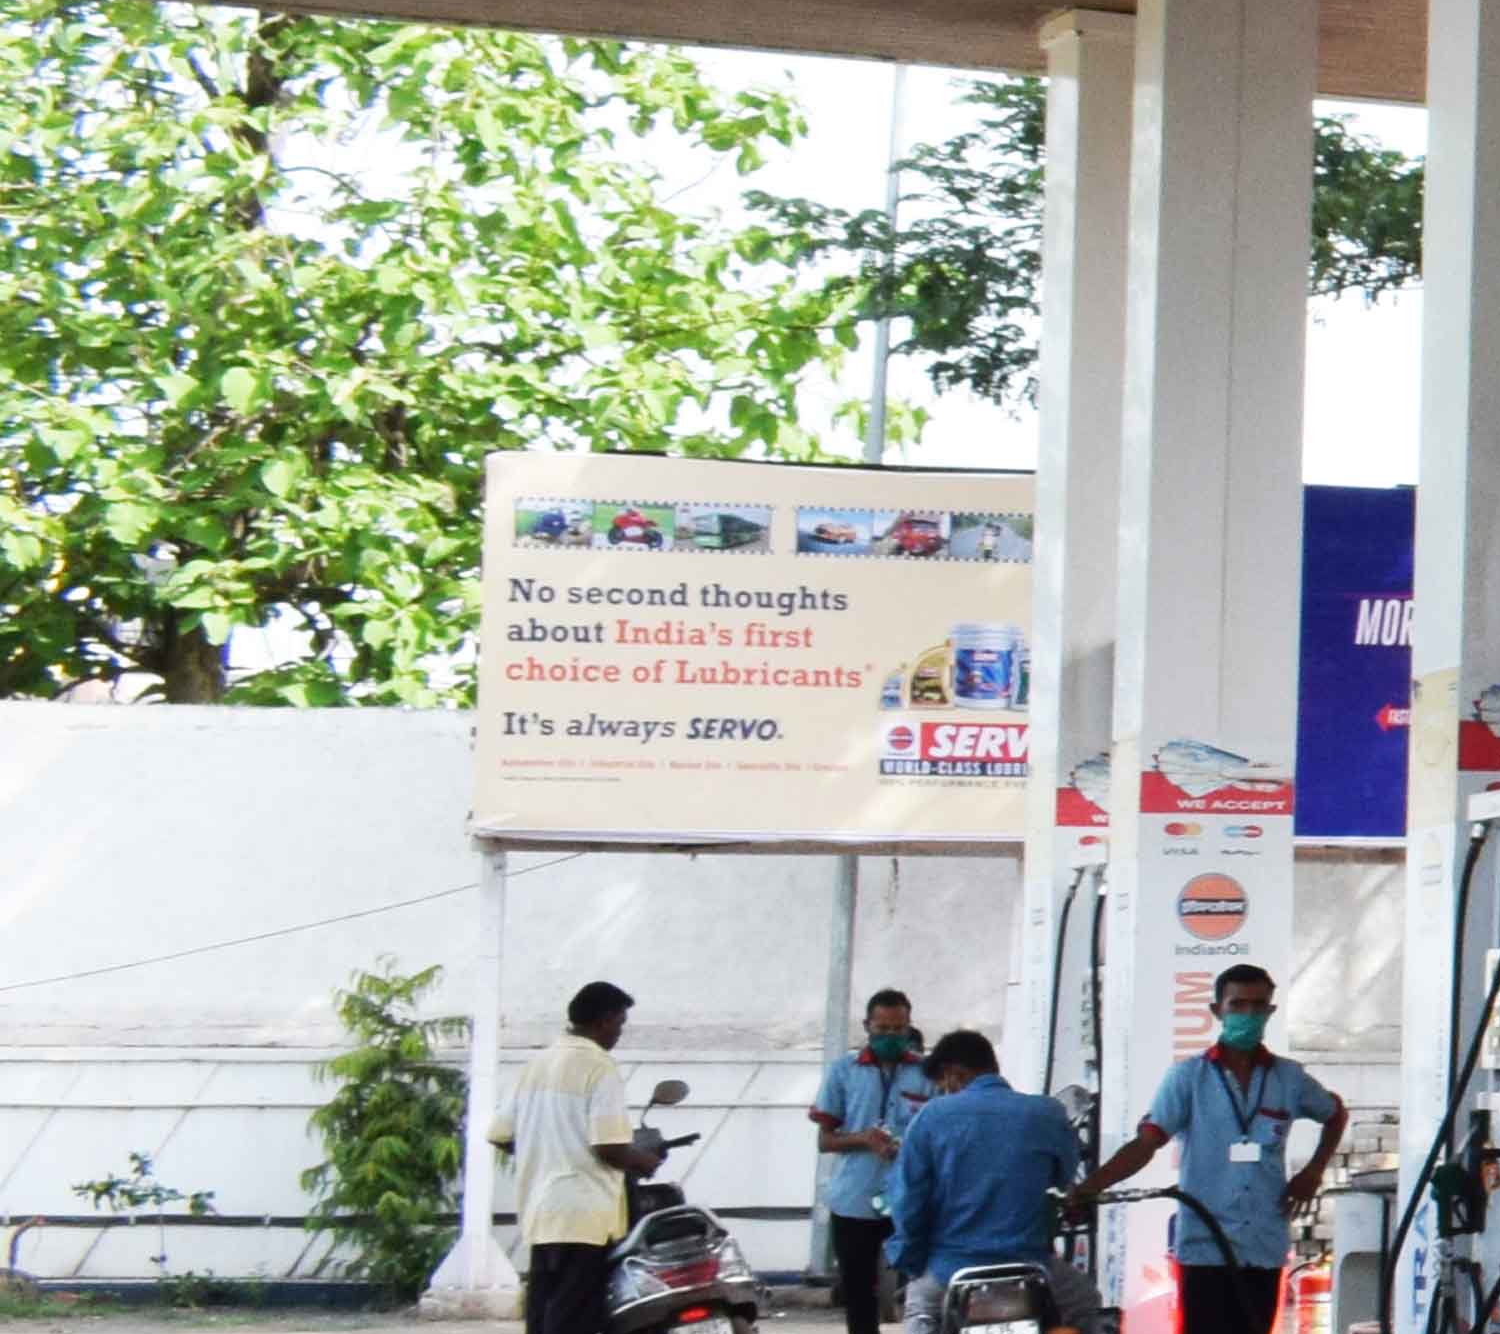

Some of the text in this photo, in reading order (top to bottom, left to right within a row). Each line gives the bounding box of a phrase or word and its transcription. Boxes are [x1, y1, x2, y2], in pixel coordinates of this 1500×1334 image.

[508, 578, 849, 616] No second thoughts
[507, 620, 815, 648] about India's first
[1355, 598, 1414, 646] MOR
[505, 658, 620, 685] choice
[631, 659, 664, 685] of
[502, 711, 785, 742] It's always SERVO.
[928, 724, 1030, 759] SERV
[1176, 799, 1286, 811] WE ACCEPT
[1173, 942, 1250, 956] IndianOil
